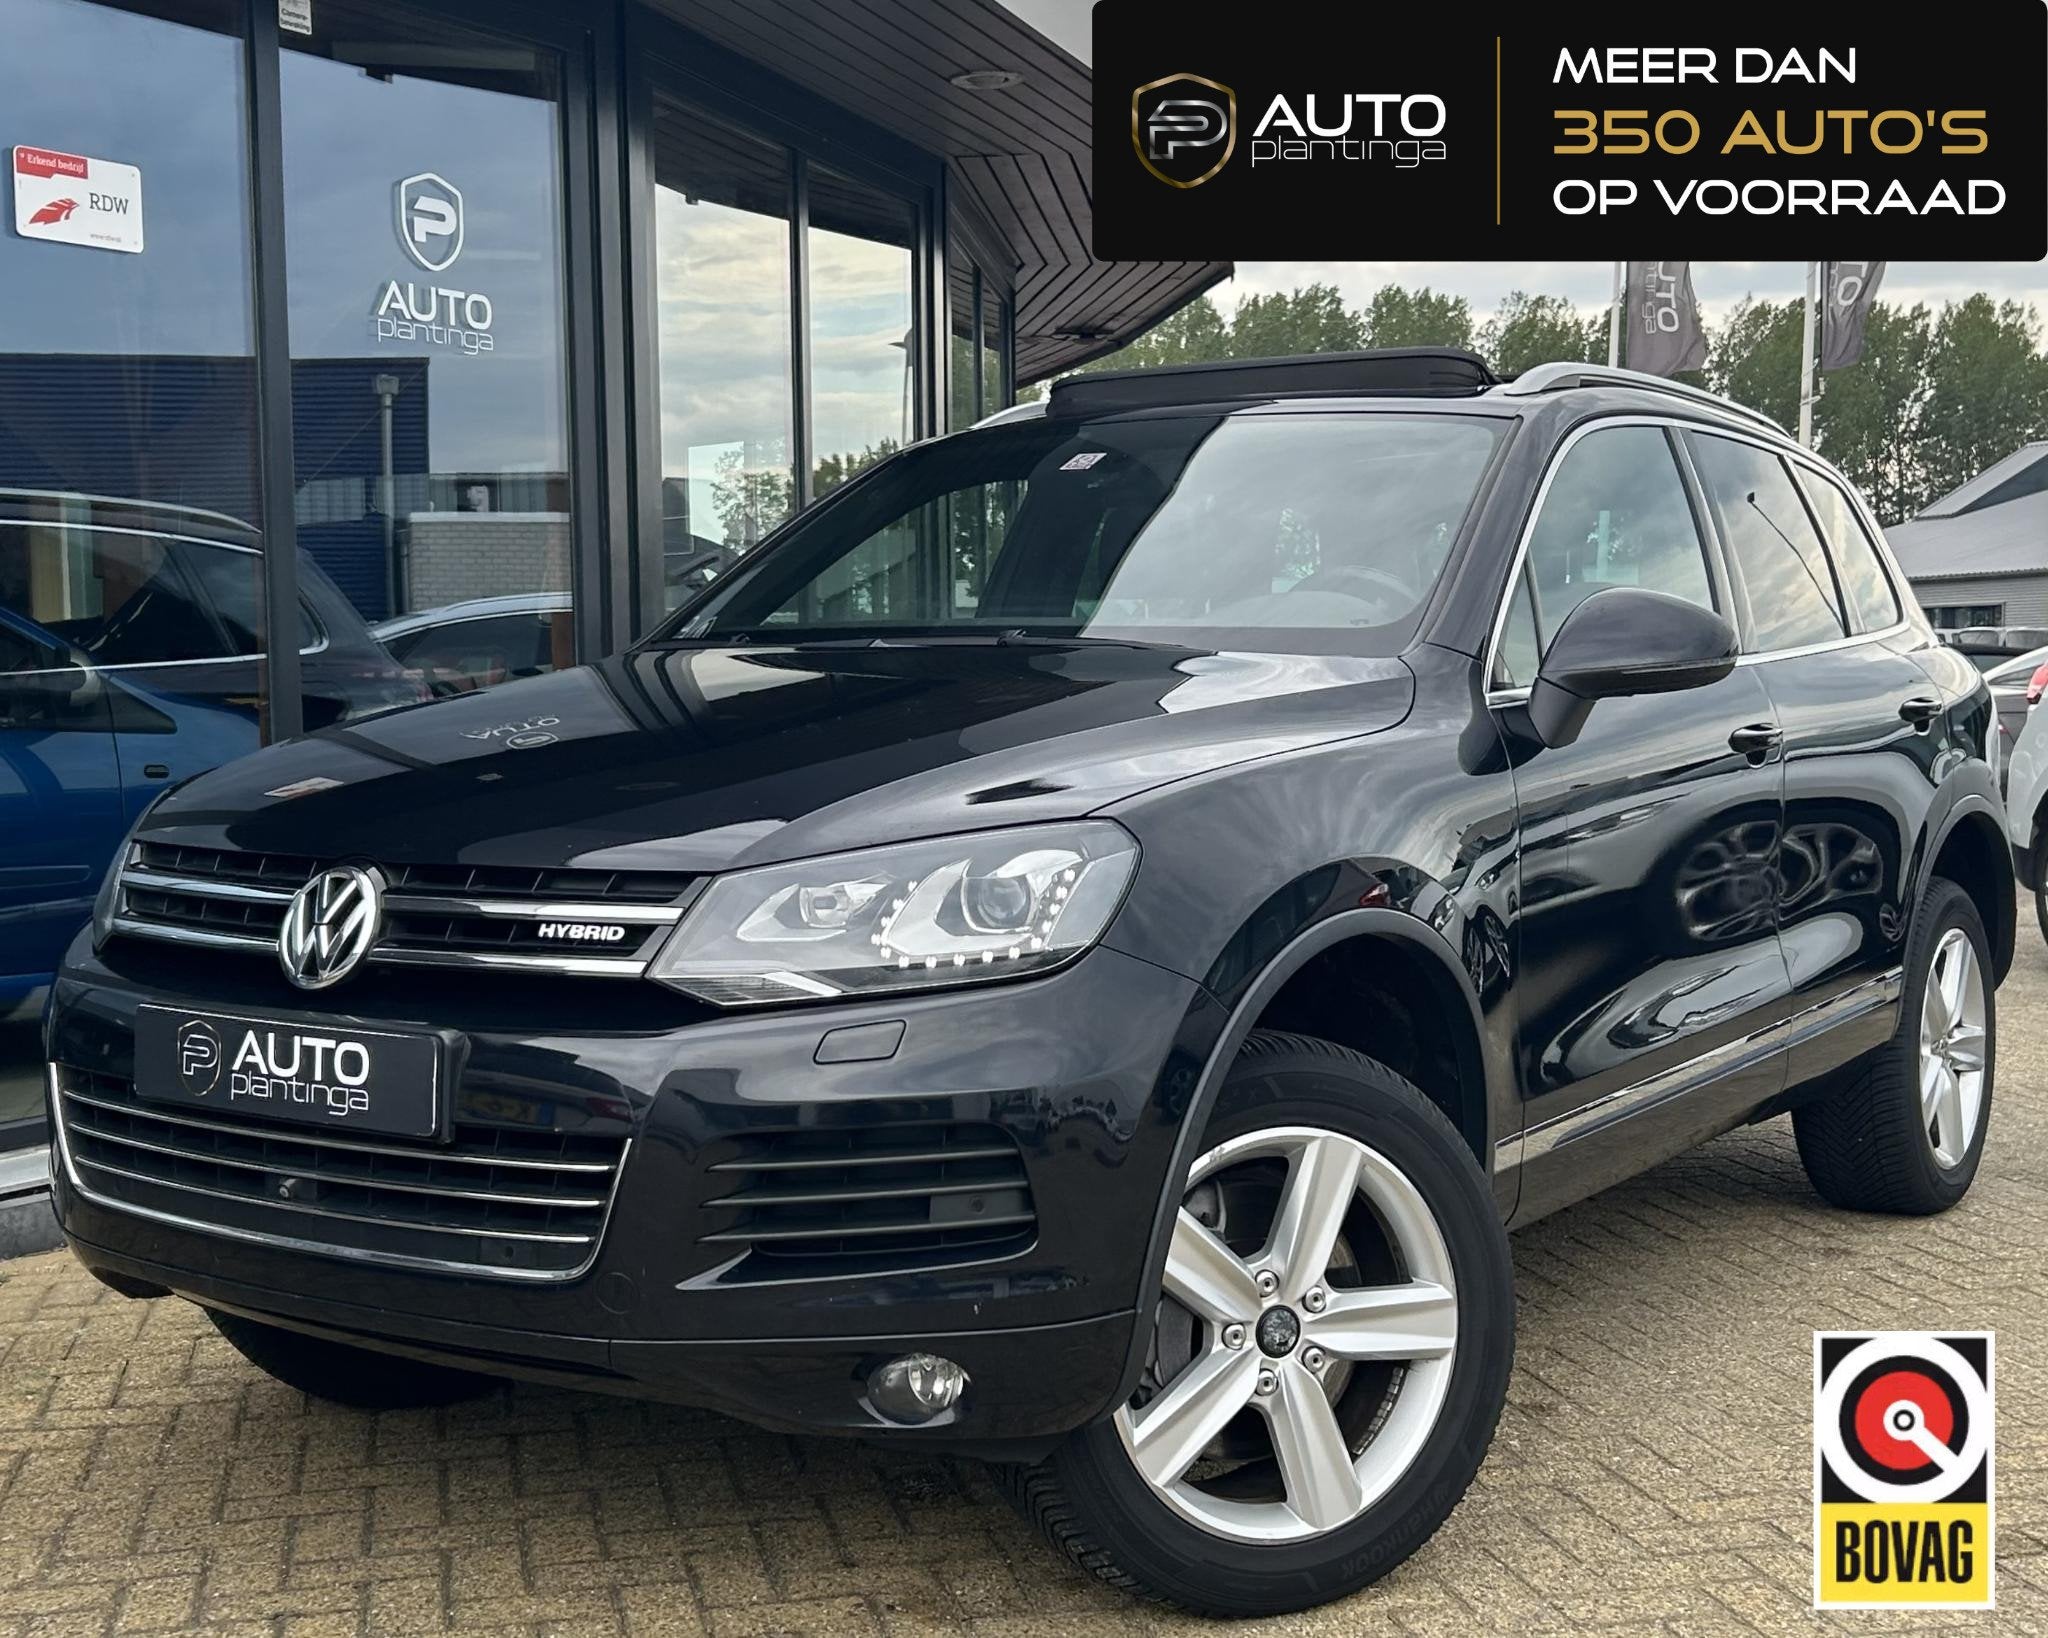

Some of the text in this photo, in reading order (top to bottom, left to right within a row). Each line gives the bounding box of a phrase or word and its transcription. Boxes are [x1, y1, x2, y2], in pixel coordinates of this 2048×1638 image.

[88, 191, 129, 215] RDW
[377, 279, 493, 331] AUTO
[1656, 261, 1681, 333] UTO
[376, 317, 495, 356] plantinga
[537, 923, 626, 942] HYBRID
[231, 1029, 370, 1086] AUTO
[230, 1070, 370, 1117] plantinga
